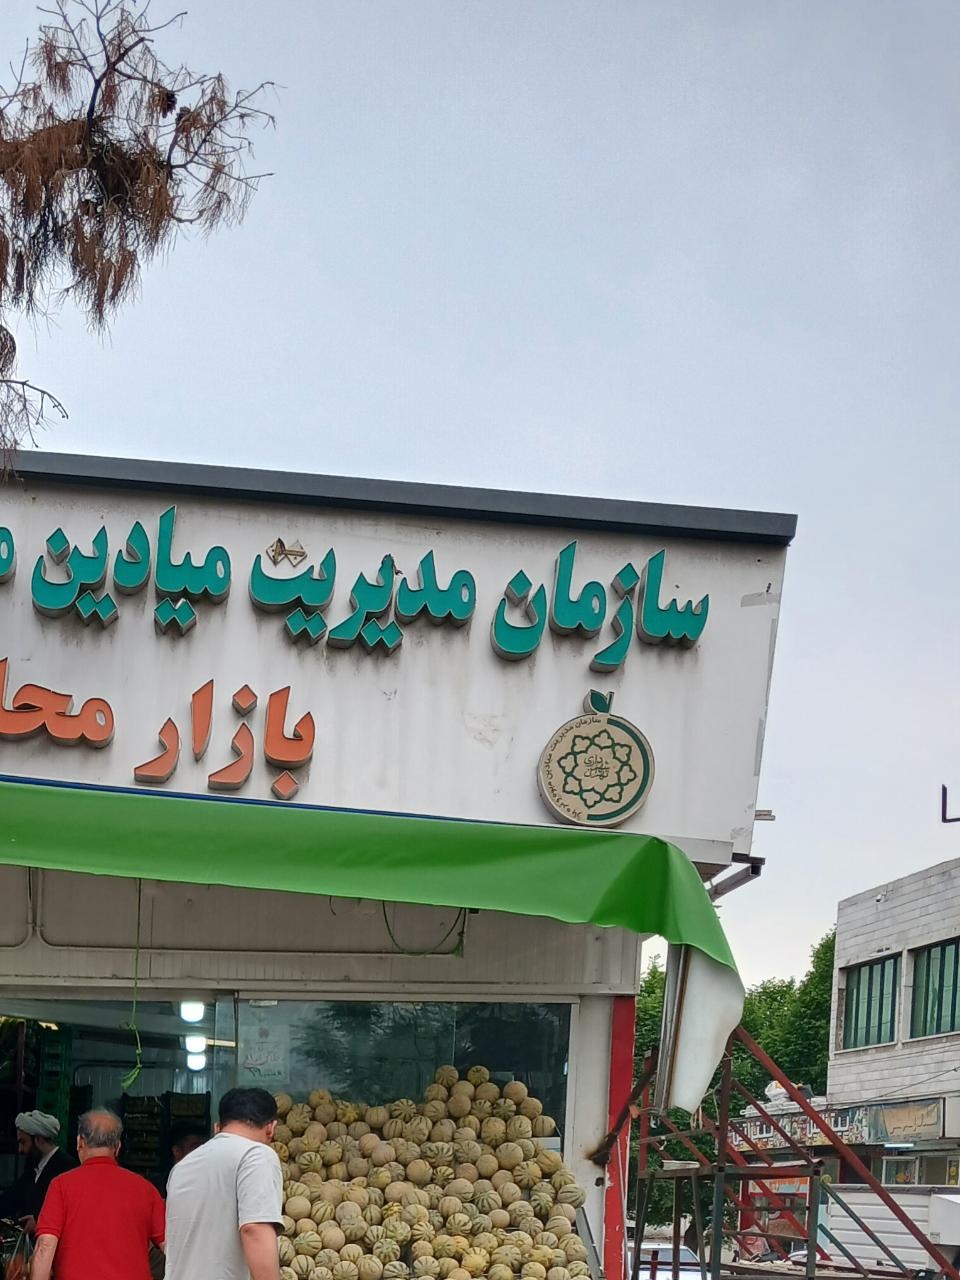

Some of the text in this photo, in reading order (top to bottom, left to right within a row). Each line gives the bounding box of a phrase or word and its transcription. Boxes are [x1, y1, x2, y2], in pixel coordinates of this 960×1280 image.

[31, 504, 232, 635] میادین
[248, 540, 477, 656] مدیریت
[490, 539, 710, 672] سازمان
[134, 678, 316, 799] بازار
